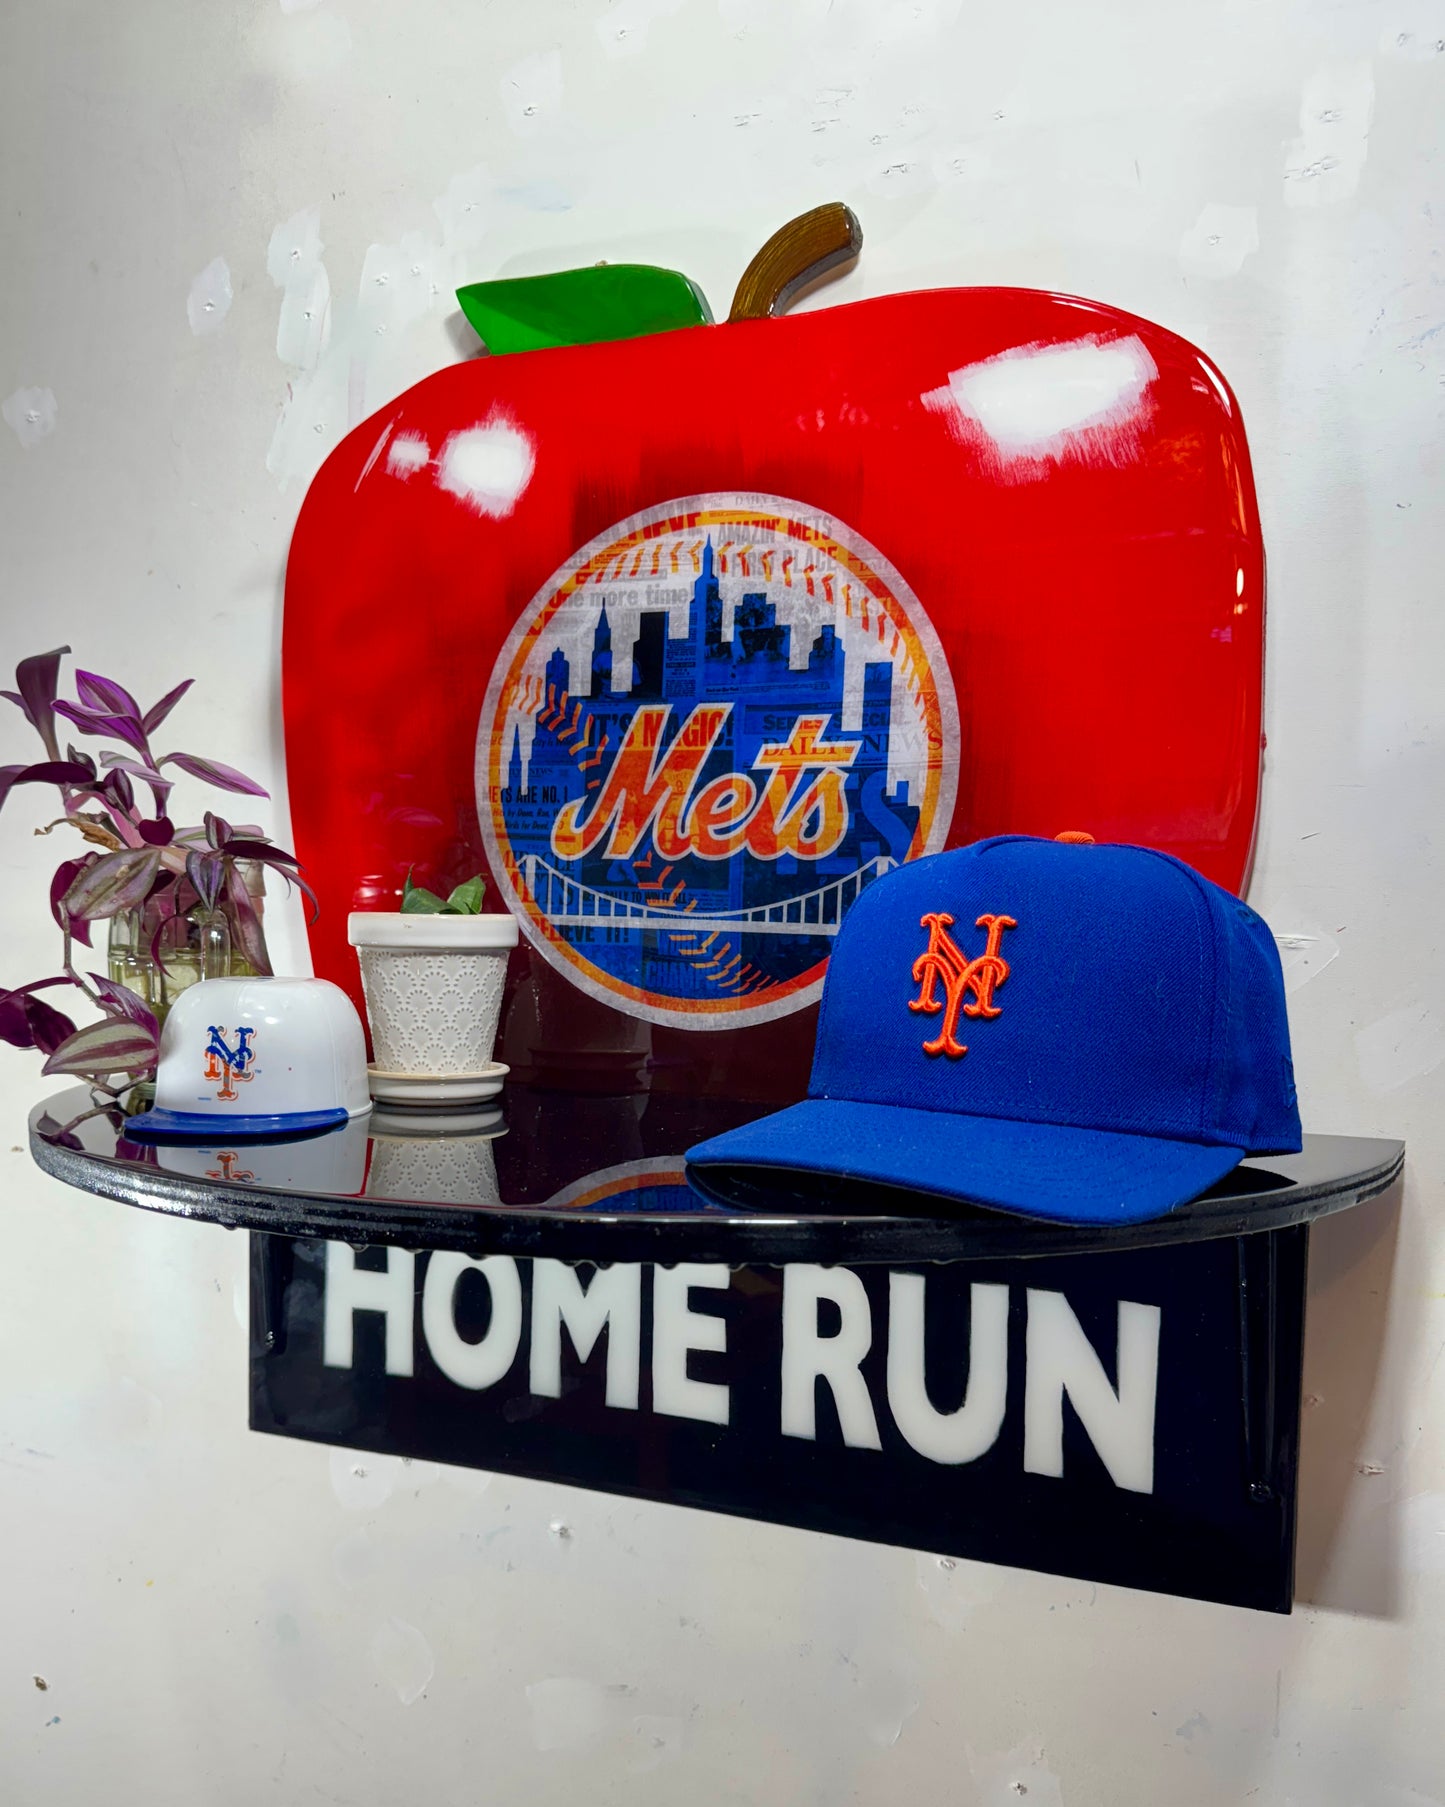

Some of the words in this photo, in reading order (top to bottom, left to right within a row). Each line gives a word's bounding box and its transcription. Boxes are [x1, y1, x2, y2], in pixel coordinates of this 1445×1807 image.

[787, 513, 834, 542] METS
[783, 545, 838, 575] PLACE
[549, 587, 585, 608] One
[589, 589, 640, 608] more
[761, 734, 843, 757] DAILY
[862, 729, 944, 754] NEWS
[516, 785, 539, 804] ARE
[542, 785, 561, 804] NO.
[563, 785, 569, 804] 1
[551, 702, 863, 861] Mets
[323, 1240, 731, 1426] HOME
[780, 1263, 1162, 1495] RUN
